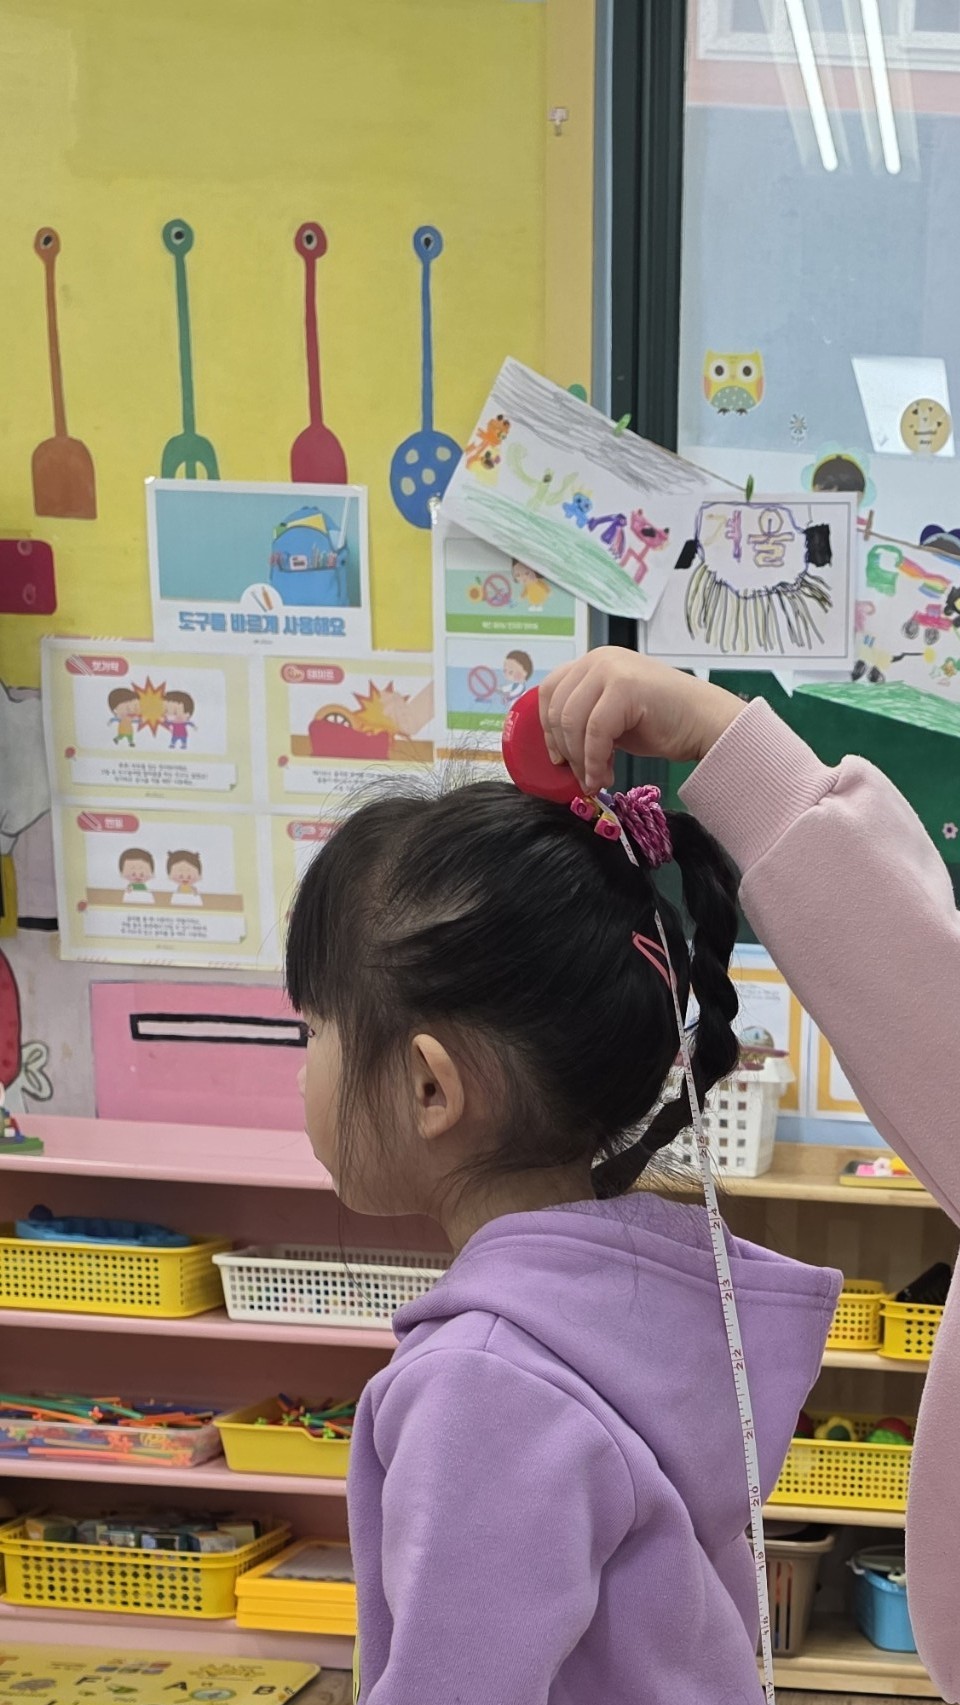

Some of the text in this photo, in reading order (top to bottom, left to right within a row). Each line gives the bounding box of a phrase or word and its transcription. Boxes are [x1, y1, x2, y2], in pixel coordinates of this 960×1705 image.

[178, 610, 347, 638] 도구를 바르게 사용해요
